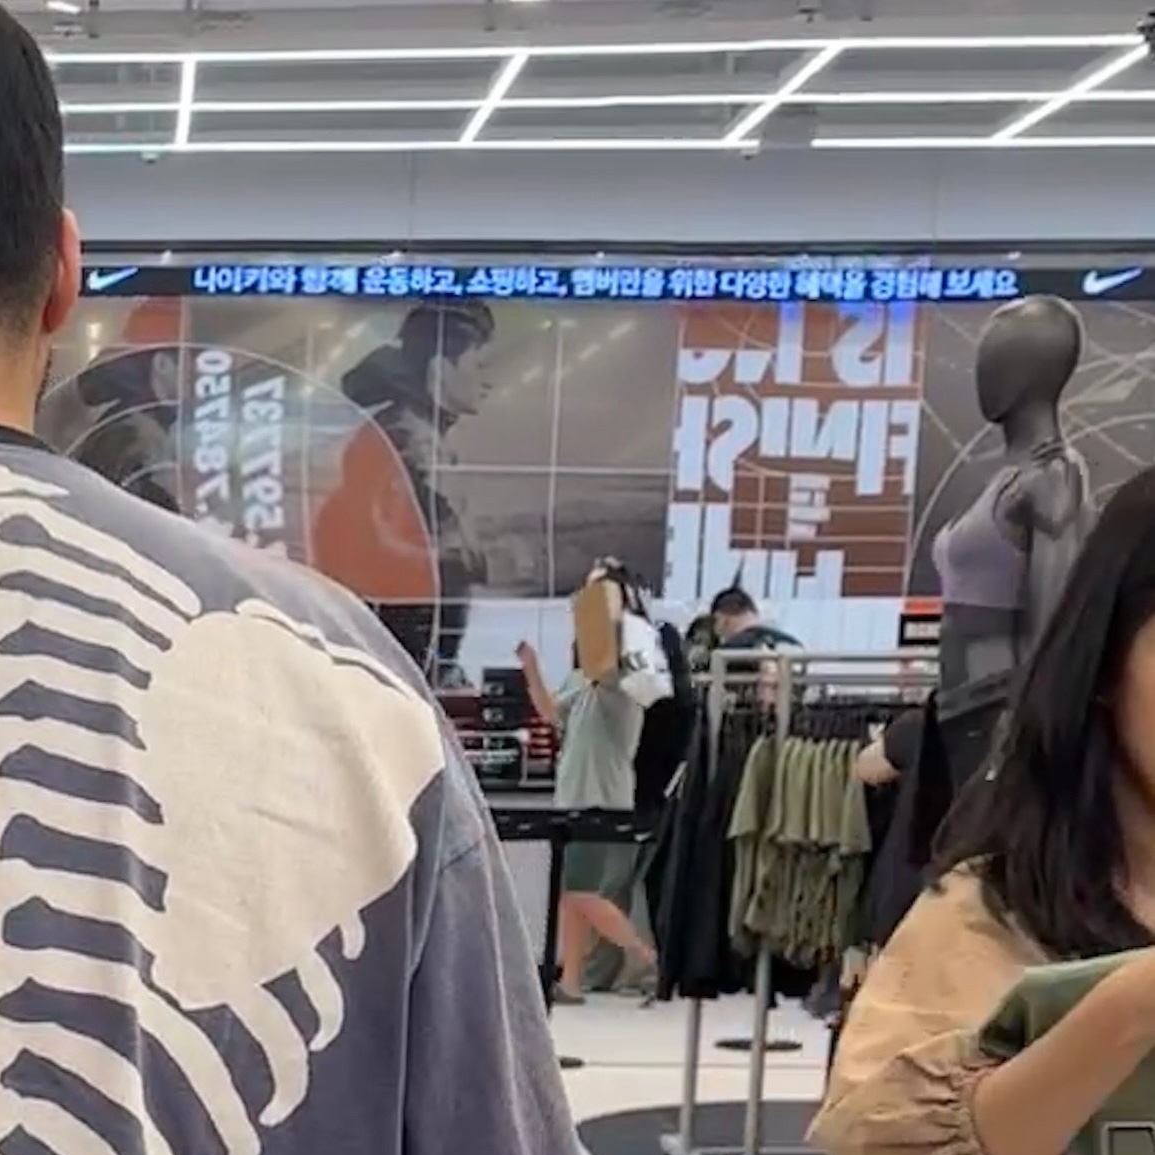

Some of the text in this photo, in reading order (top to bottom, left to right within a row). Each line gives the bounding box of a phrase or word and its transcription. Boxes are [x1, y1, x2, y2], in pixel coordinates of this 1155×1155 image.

[194, 267, 296, 294] 나이키와
[300, 267, 359, 295] 함께
[362, 267, 463, 296] 운동하고,
[667, 268, 717, 298] 위한
[719, 269, 791, 299] 다양한
